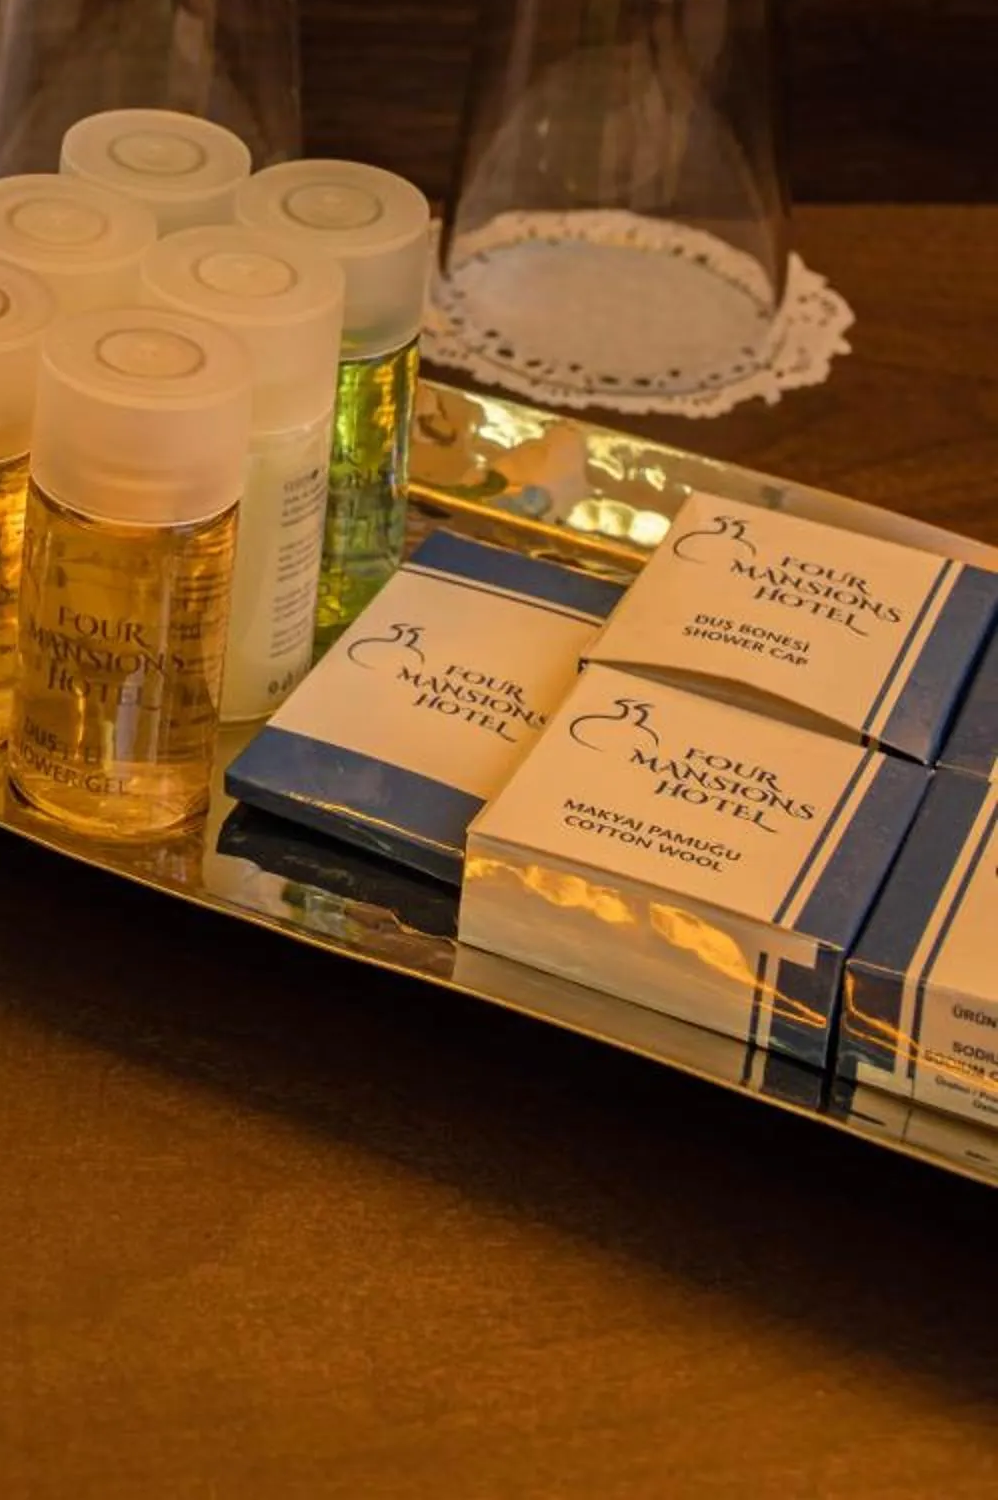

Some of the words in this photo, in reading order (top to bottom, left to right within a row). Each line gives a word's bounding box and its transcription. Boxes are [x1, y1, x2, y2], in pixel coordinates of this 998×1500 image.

[730, 558, 901, 624] MANSIONS
[780, 555, 871, 596] FOUR
[58, 605, 152, 649] FOUR
[753, 585, 870, 638] HOTEL
[28, 613, 185, 676] MANSIONS
[682, 625, 765, 654] SHOWER
[769, 647, 809, 668] CAP
[396, 665, 548, 732] MANSIONS
[446, 665, 527, 706] FOUR
[412, 692, 518, 744] HOTEL
[85, 774, 131, 796] GEL
[630, 747, 816, 821] MANSIONS
[685, 747, 783, 793] FOUR
[654, 779, 779, 835] HOTEL
[564, 814, 653, 849] COTTON
[658, 842, 725, 874] WOOL
